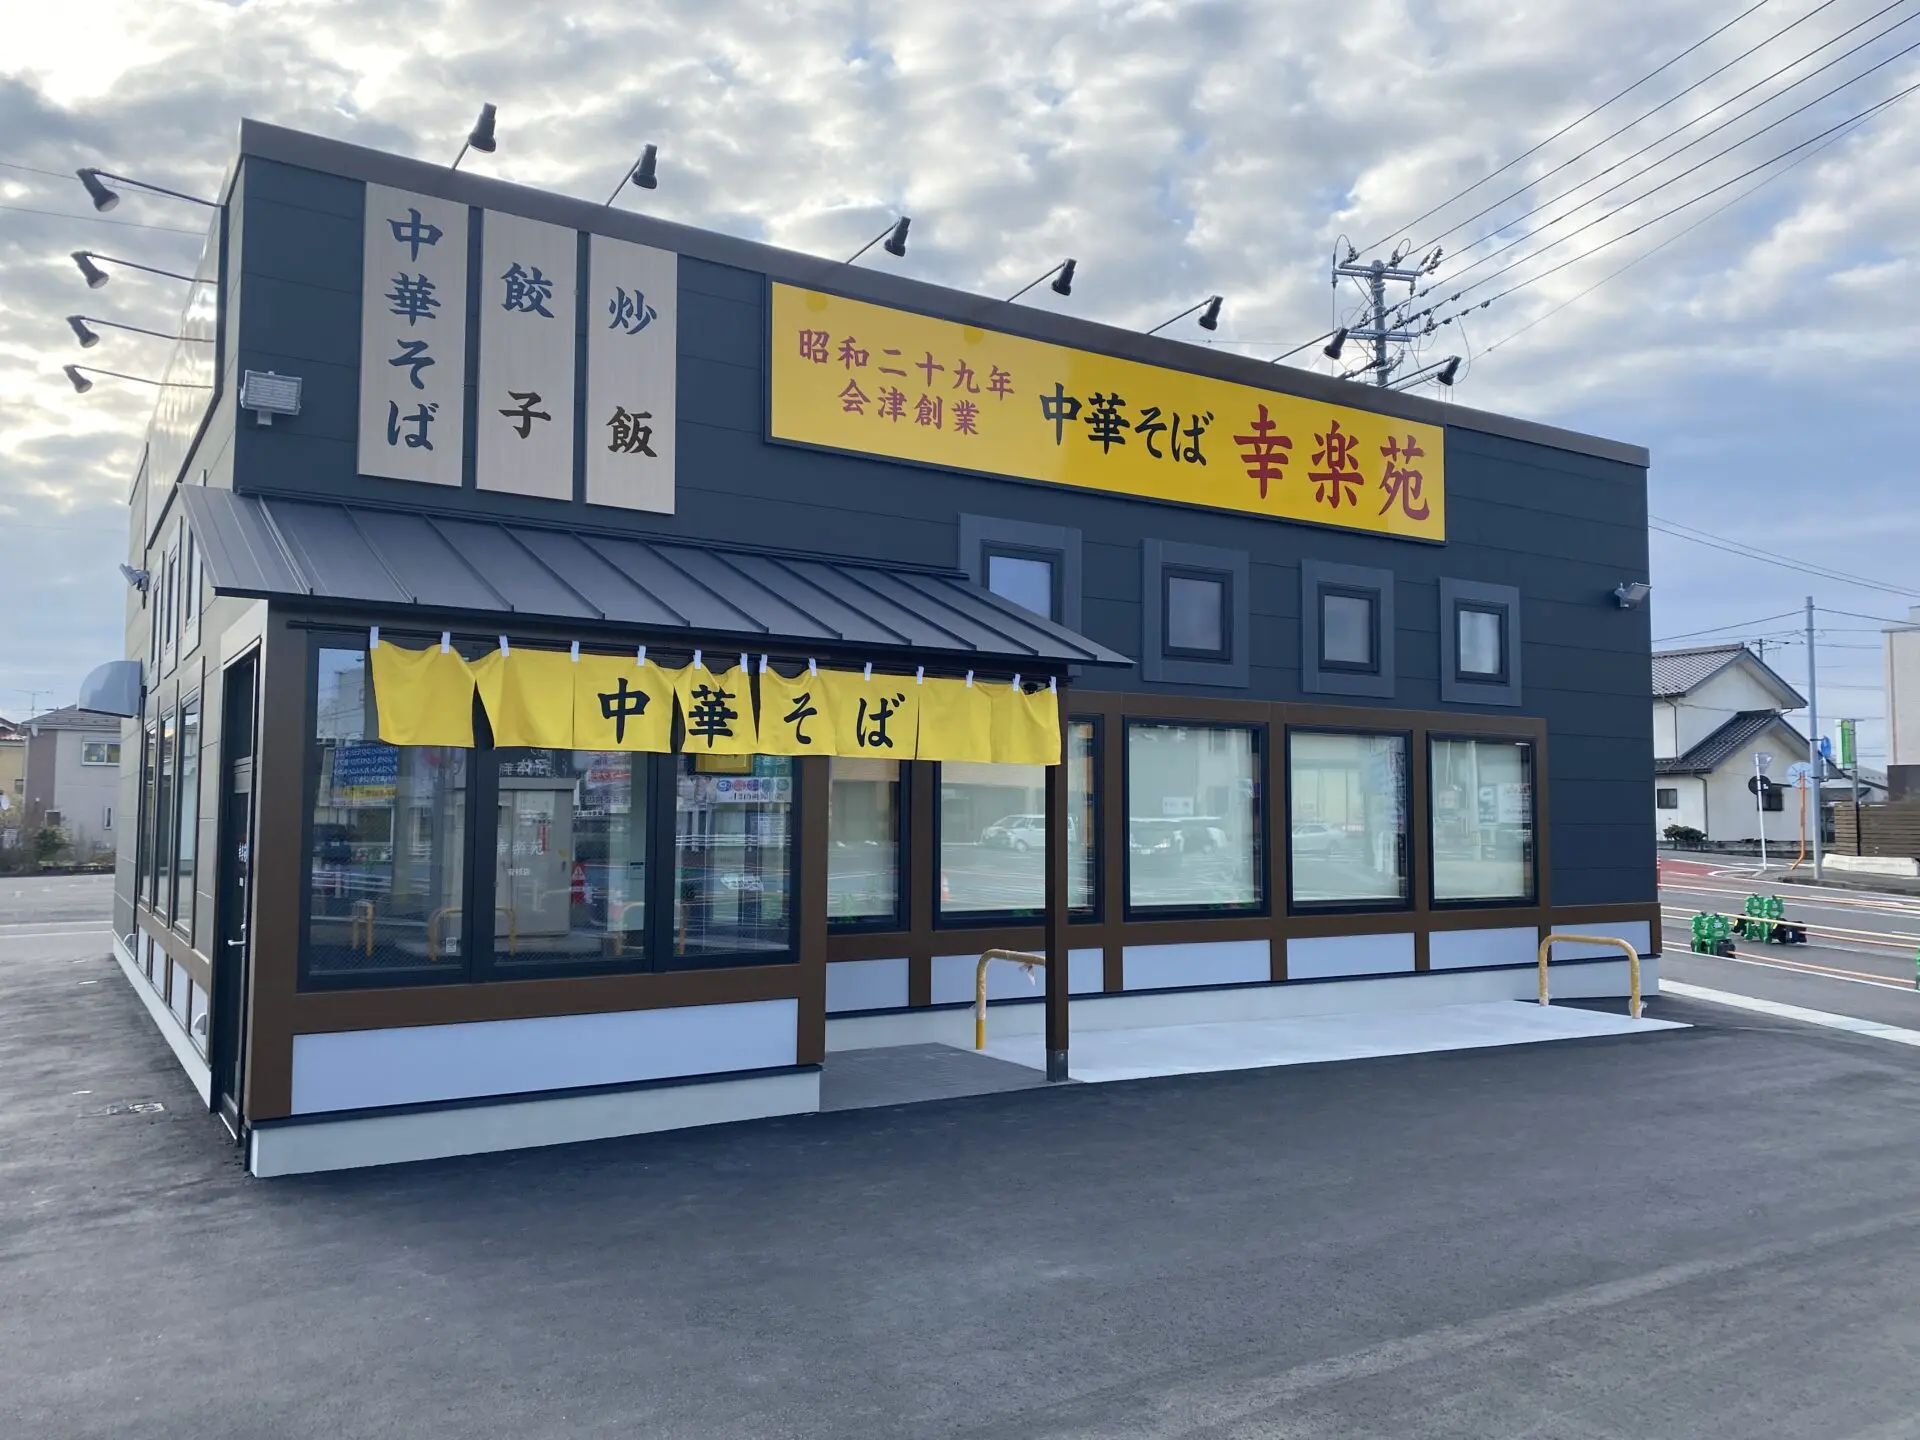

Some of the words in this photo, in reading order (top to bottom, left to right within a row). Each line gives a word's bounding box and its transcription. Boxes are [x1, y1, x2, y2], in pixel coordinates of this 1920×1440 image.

[385, 207, 443, 450] 中華そば
[499, 262, 555, 439] 餃子
[606, 286, 658, 458] 炒飯
[798, 329, 1015, 400] 昭和二十九年
[838, 379, 980, 435] 会津創業
[1039, 382, 1214, 467] 中華そば
[1233, 404, 1431, 521] 幸楽苑
[597, 678, 905, 748] 中華そば
